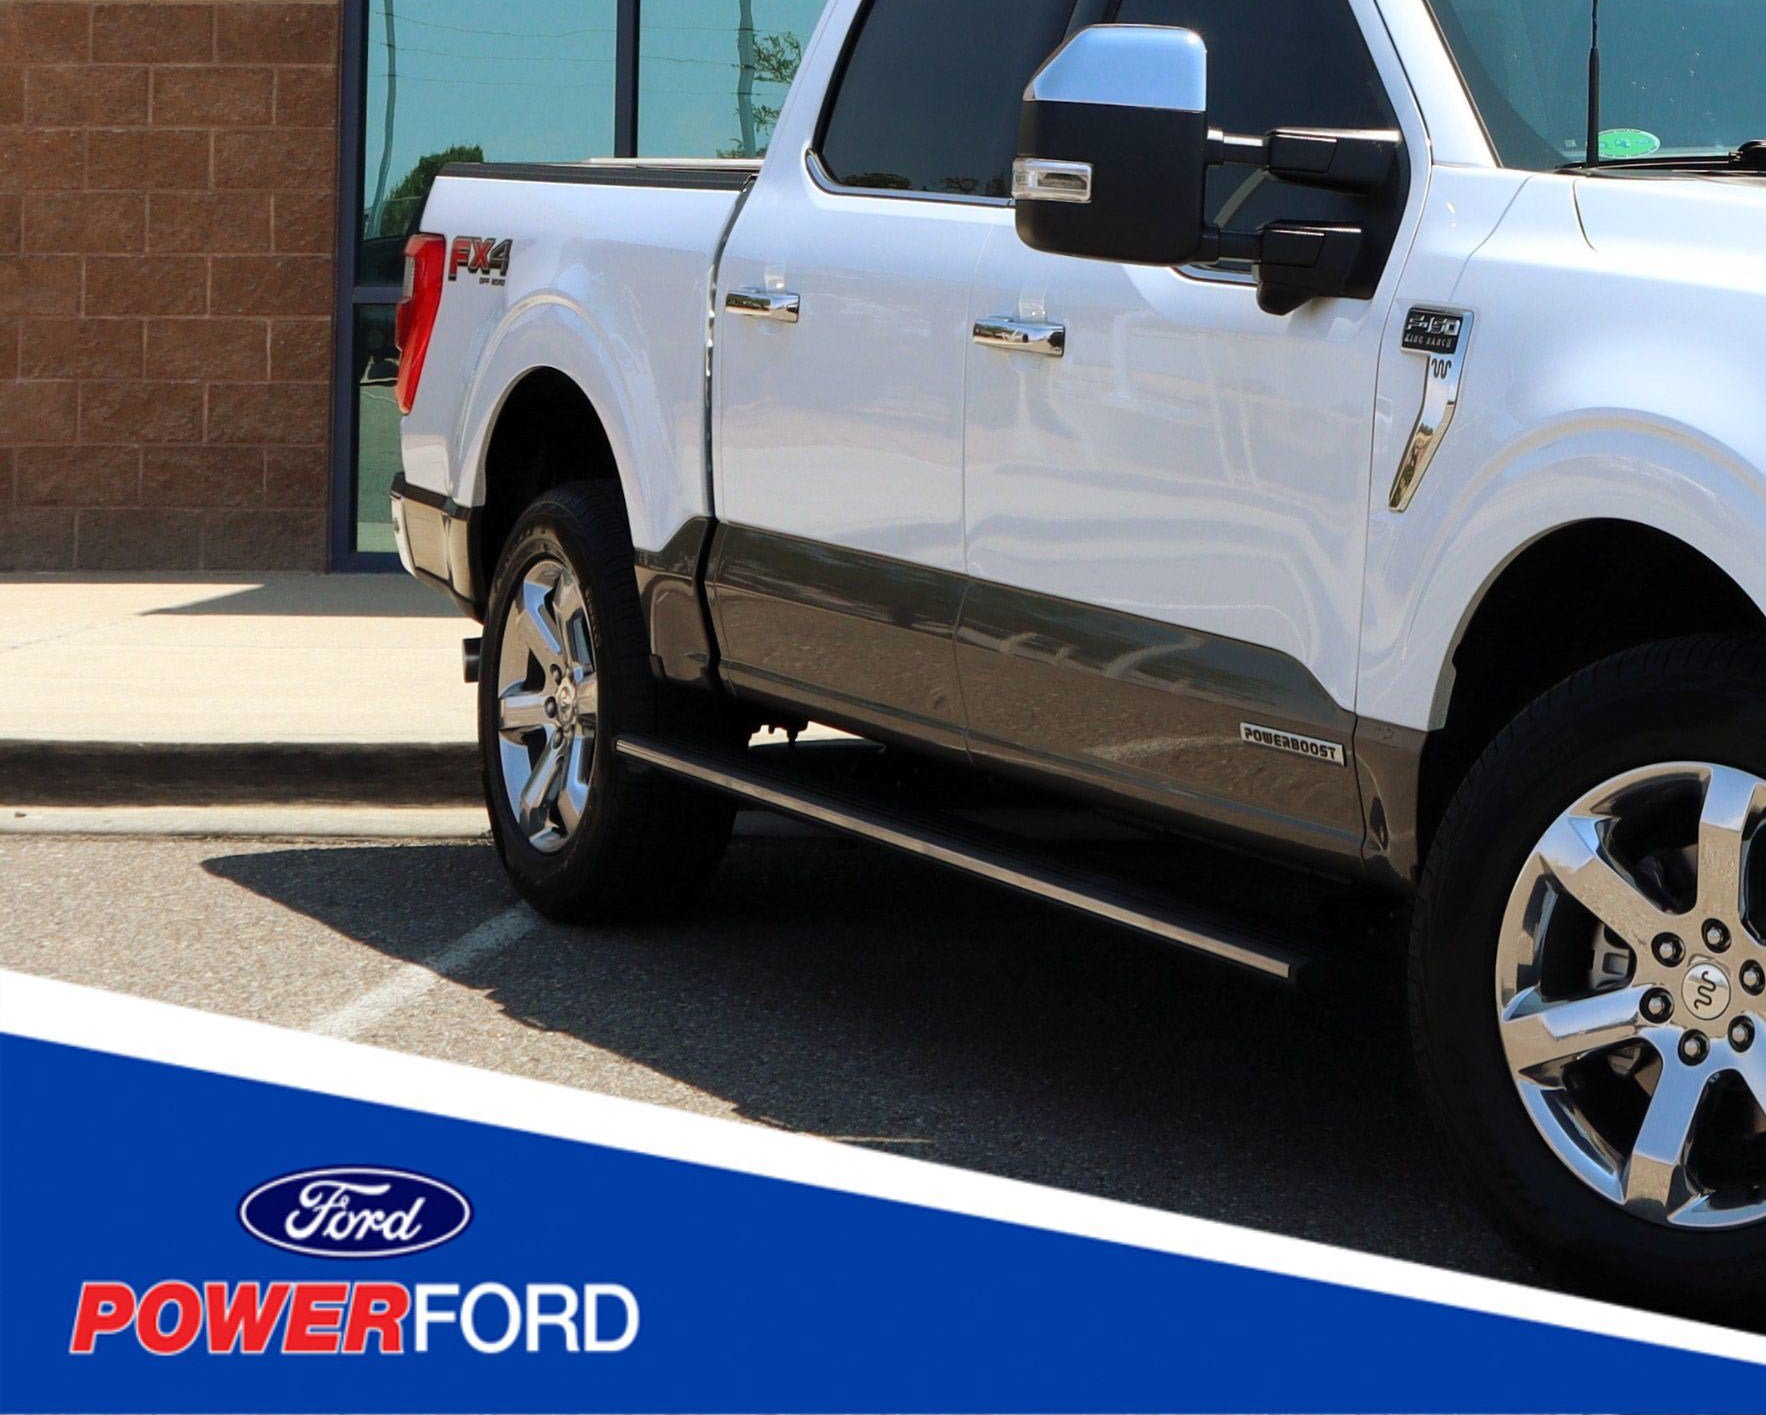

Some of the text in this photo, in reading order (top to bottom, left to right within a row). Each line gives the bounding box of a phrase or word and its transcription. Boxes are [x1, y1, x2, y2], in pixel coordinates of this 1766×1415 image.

[448, 235, 513, 281] FX4
[1406, 315, 1460, 333] F-150
[1243, 727, 1337, 760] POWERBOOST
